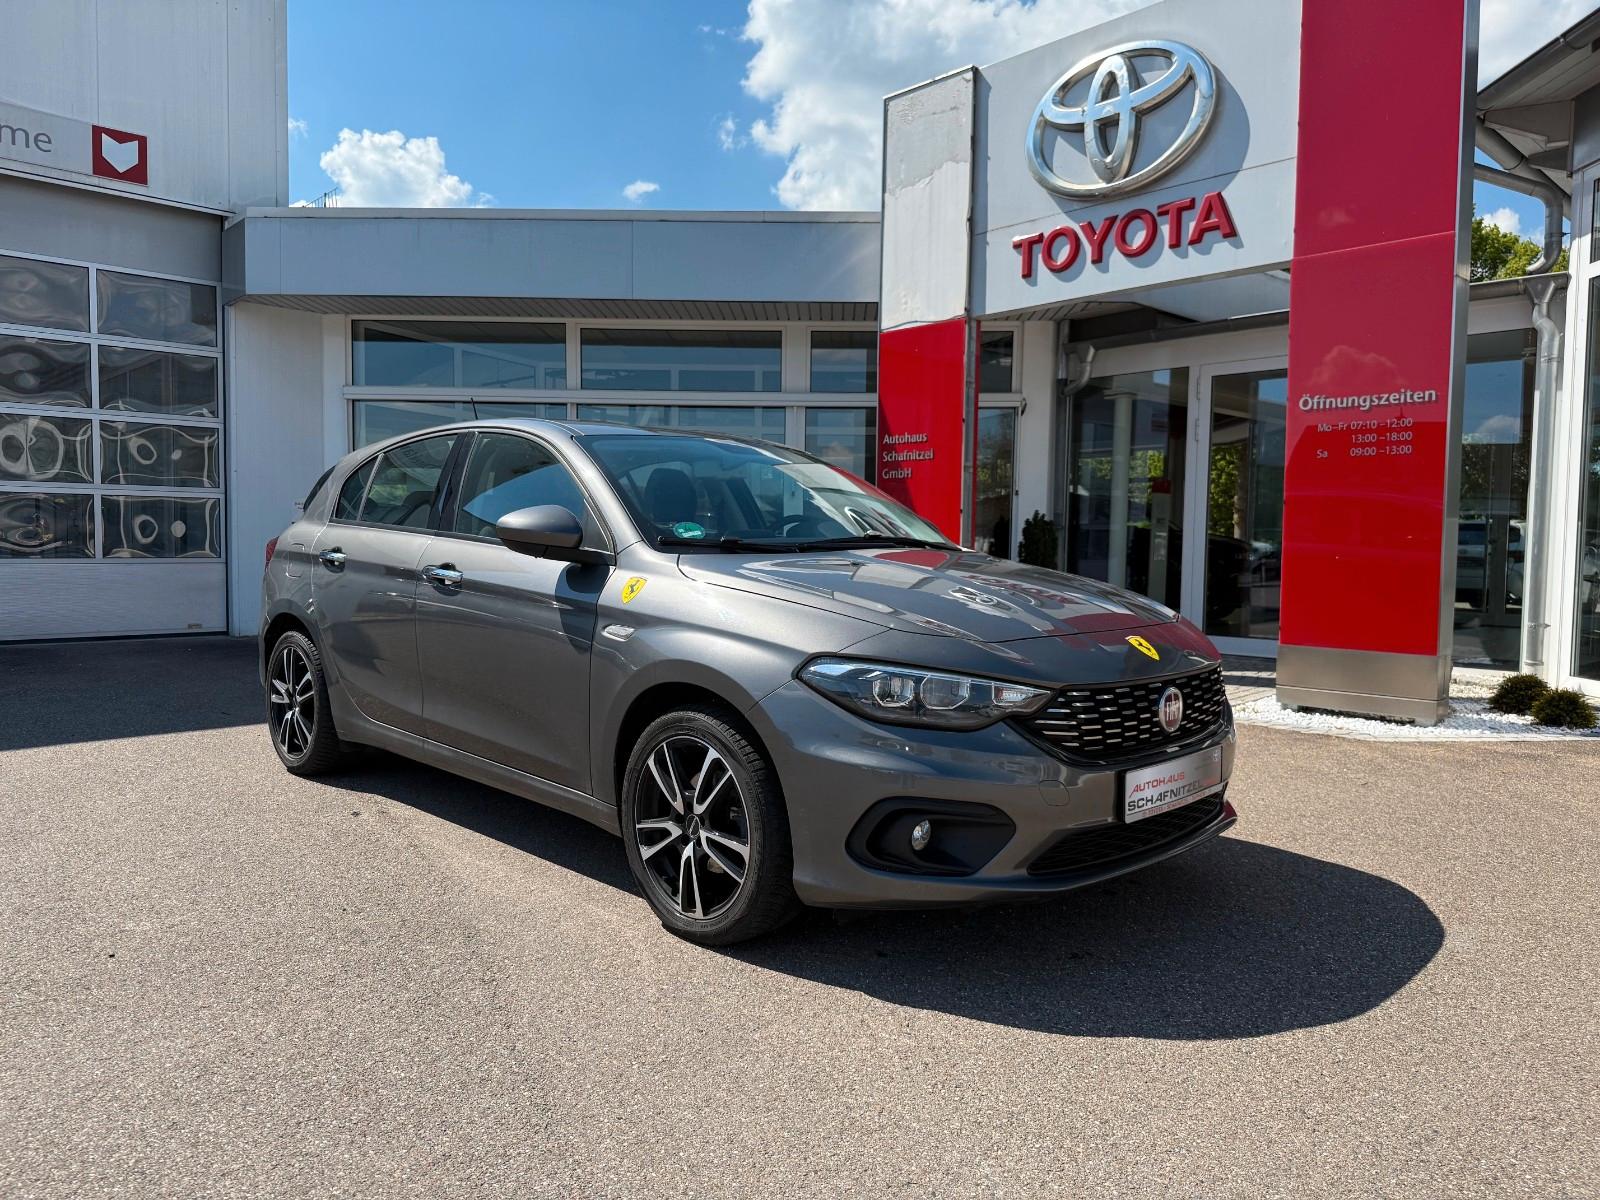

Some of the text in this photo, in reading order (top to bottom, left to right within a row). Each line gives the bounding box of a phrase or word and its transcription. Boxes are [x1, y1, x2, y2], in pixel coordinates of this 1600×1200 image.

[1012, 191, 1238, 280] TOYOTA
[1298, 388, 1437, 411] Öffnungszeiten
[882, 432, 928, 444] Autohaus
[1351, 434, 1377, 443] 13:00
[882, 448, 934, 462] Schafnitzel
[1316, 449, 1328, 459] Sa
[1350, 447, 1377, 457] 09:00
[882, 467, 912, 479] GmbH
[1128, 772, 1185, 799] AUTOHAUS
